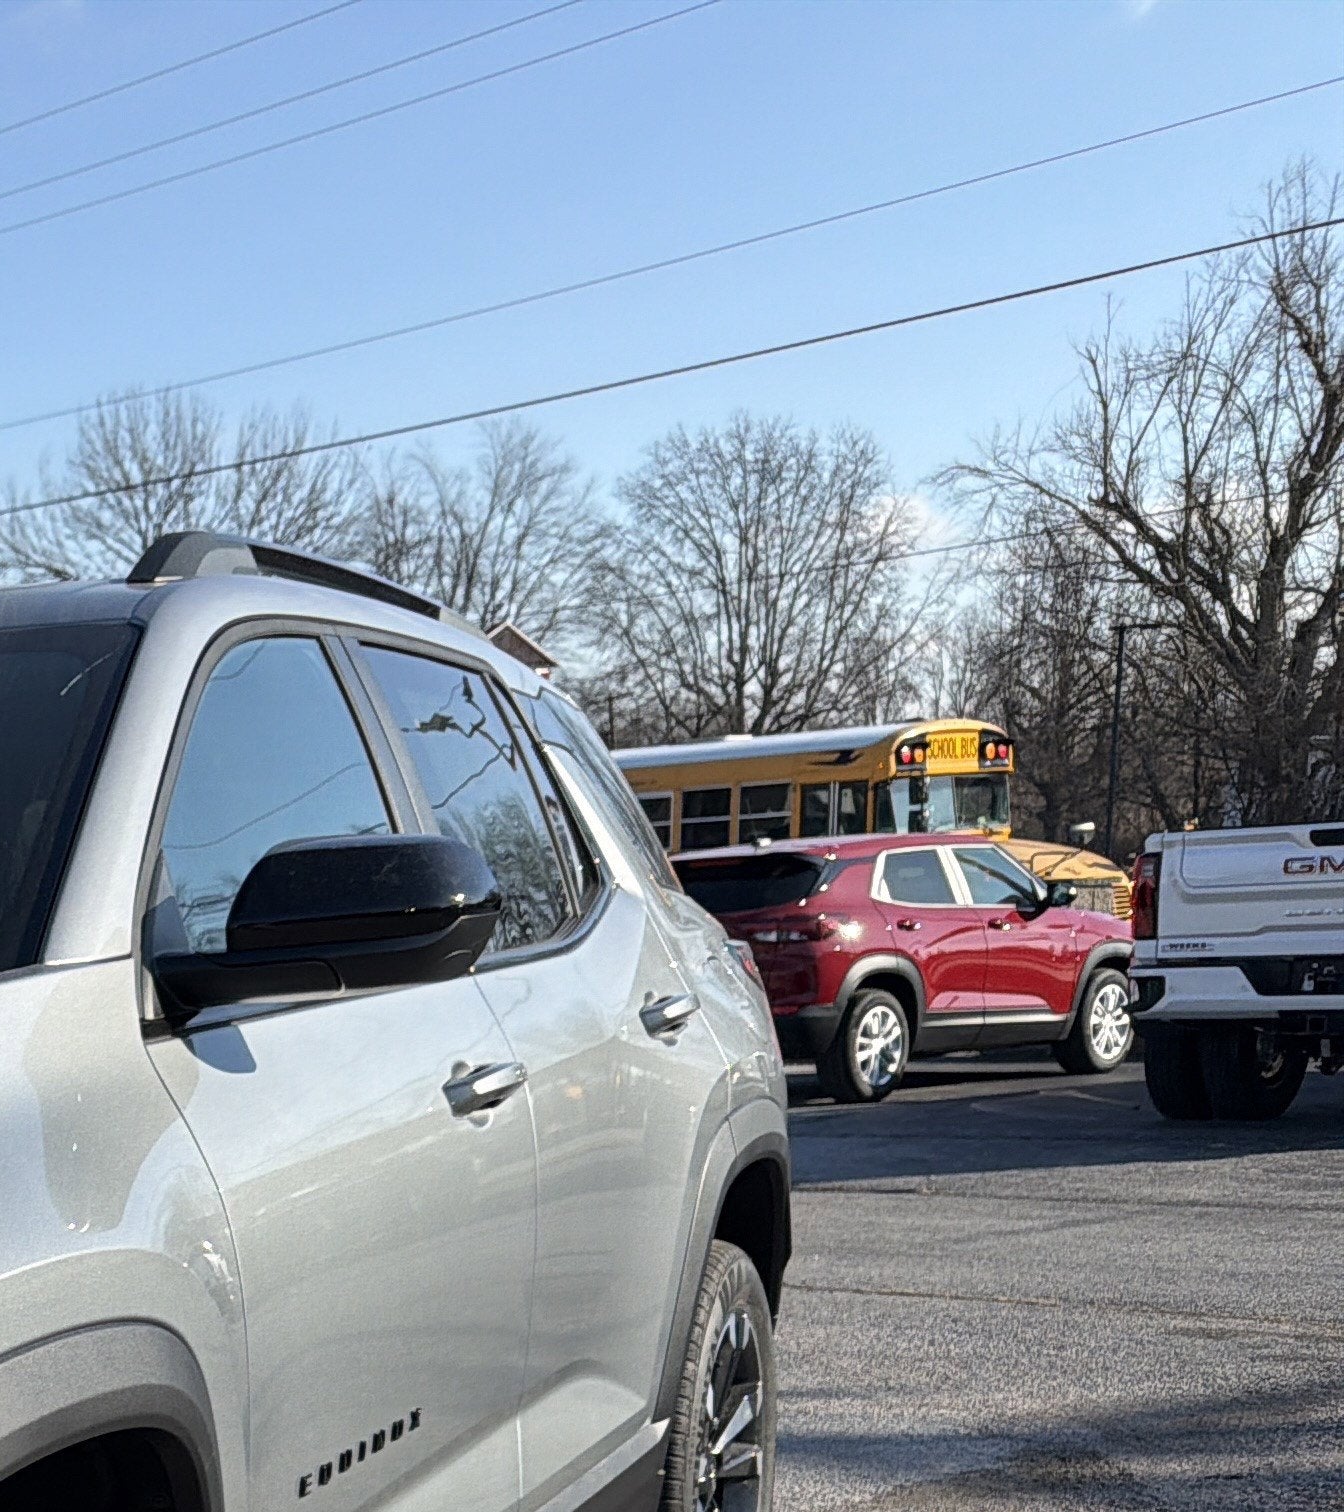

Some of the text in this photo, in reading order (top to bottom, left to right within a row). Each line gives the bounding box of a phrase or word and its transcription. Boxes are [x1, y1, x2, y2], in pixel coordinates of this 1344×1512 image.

[928, 736, 977, 760] SCHOOL BUS
[298, 1407, 422, 1498] EQUINOX
